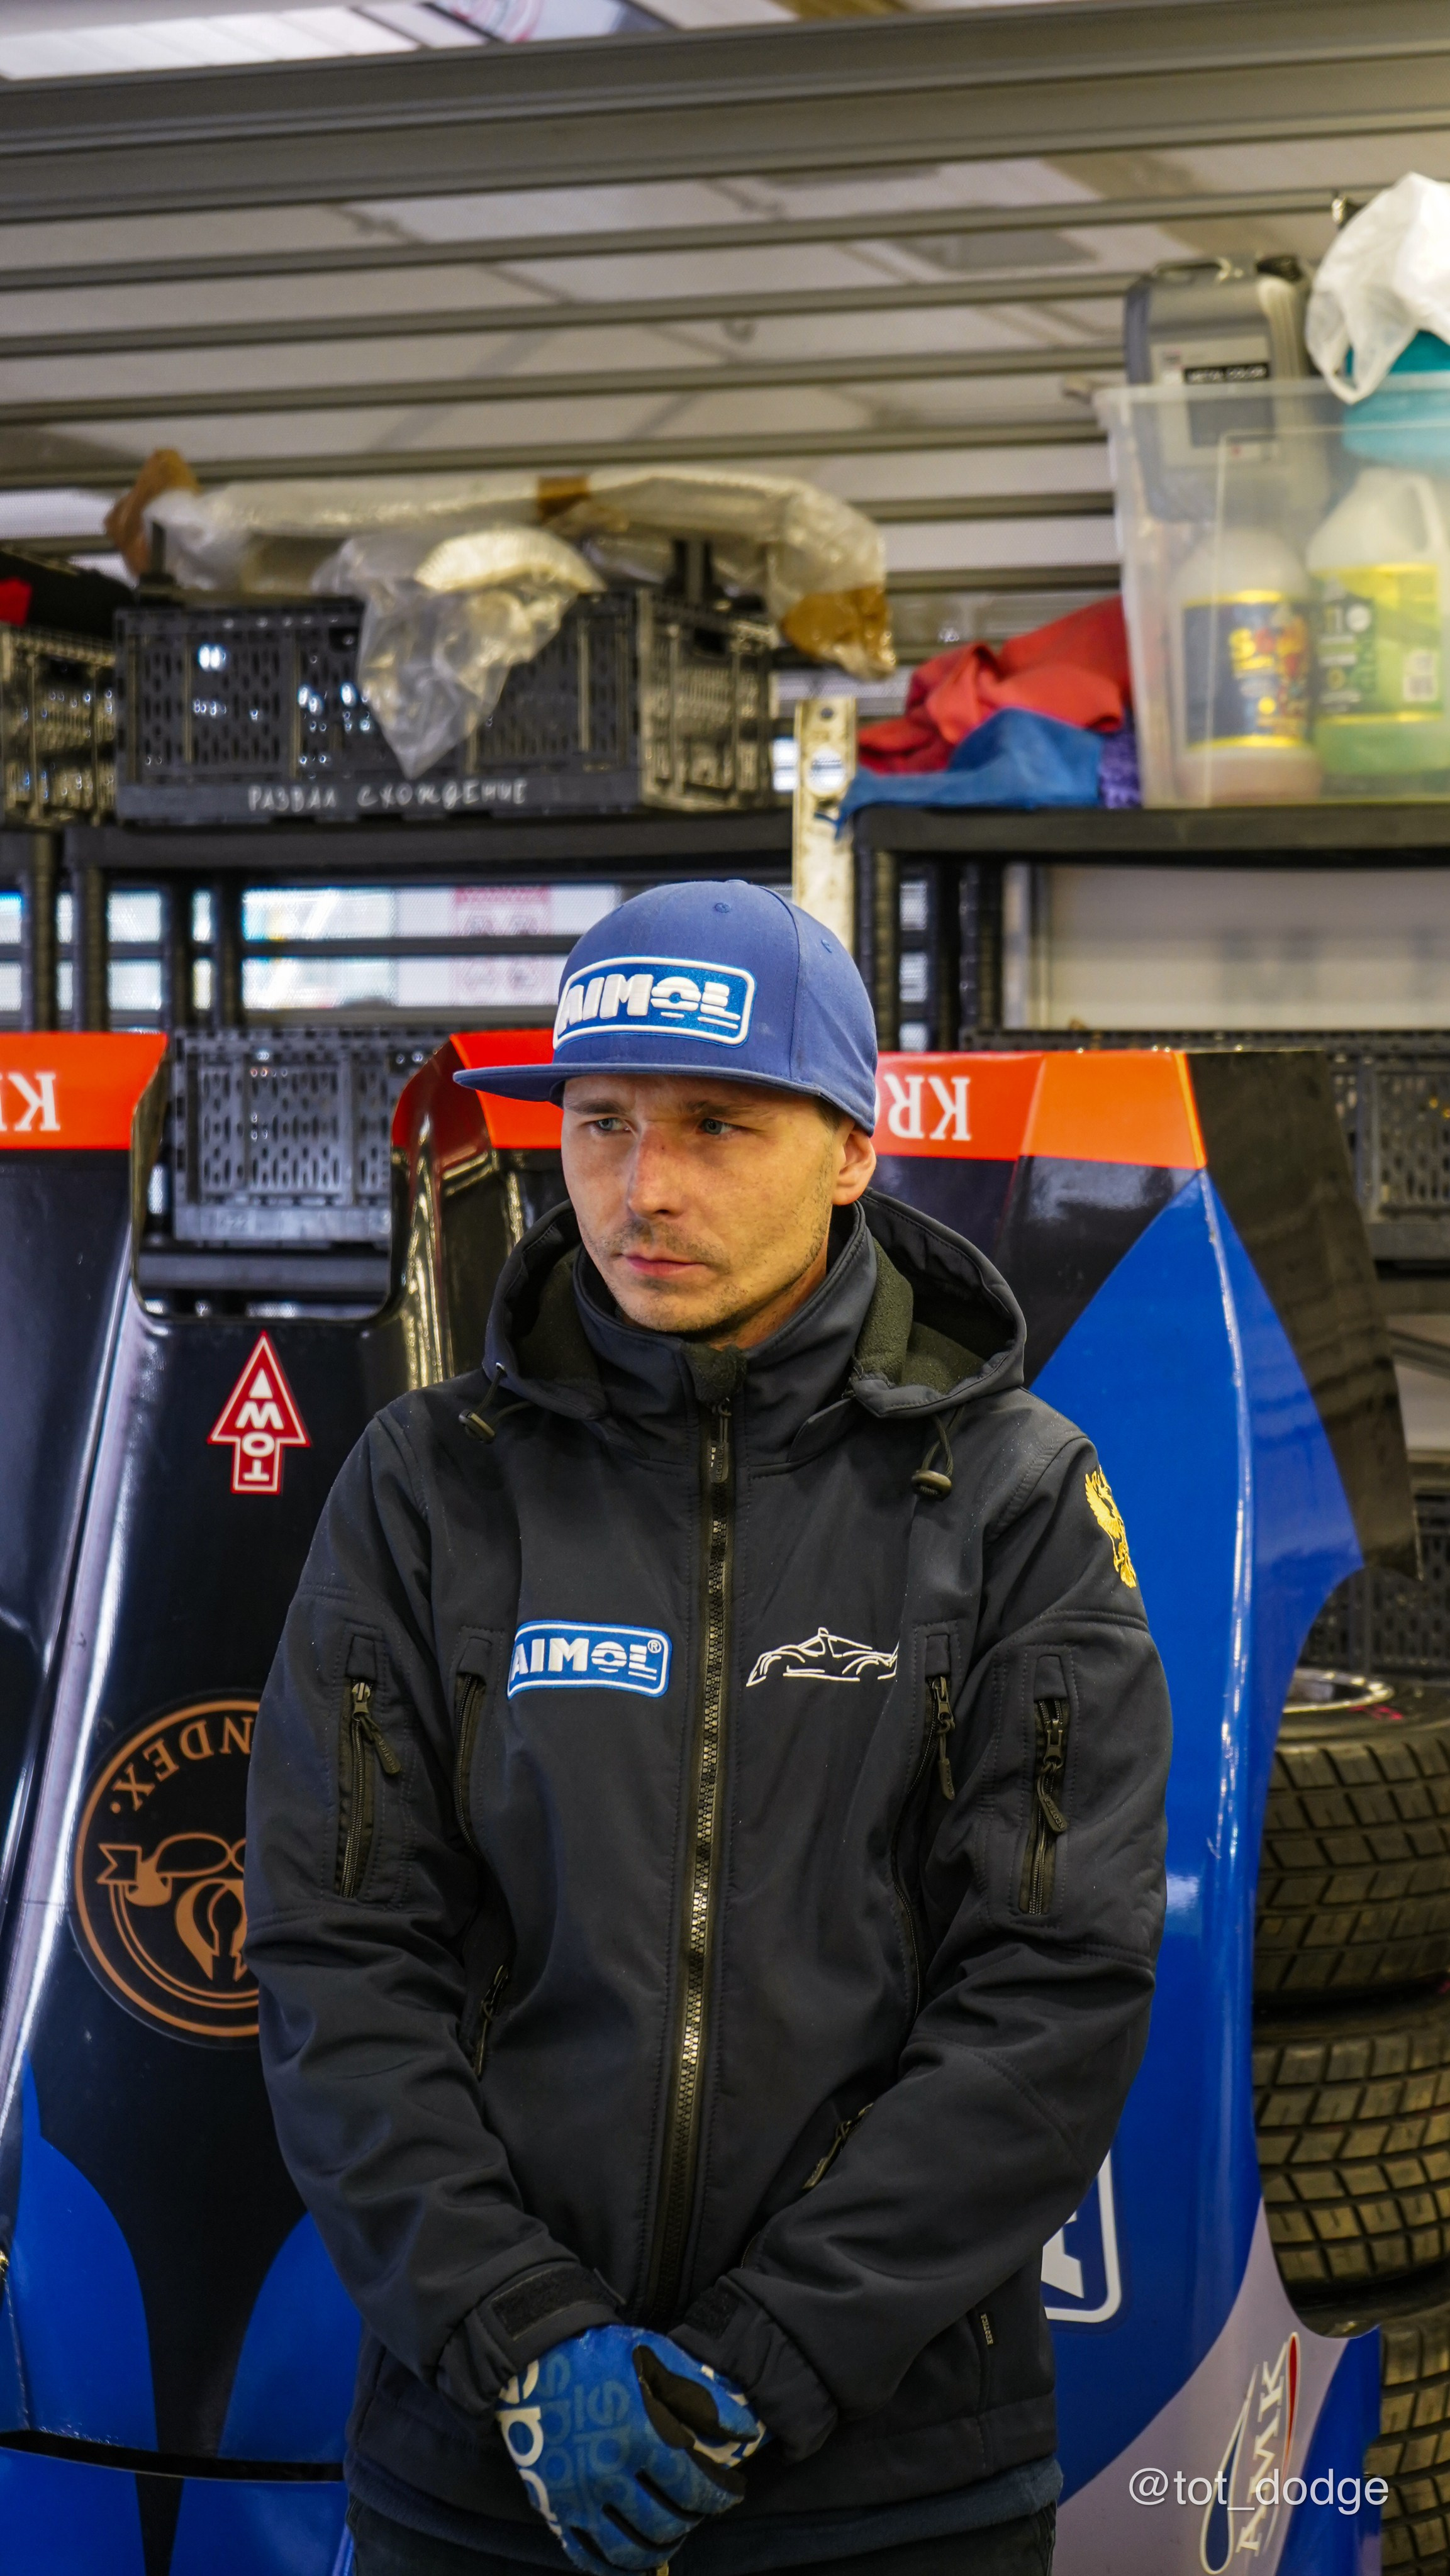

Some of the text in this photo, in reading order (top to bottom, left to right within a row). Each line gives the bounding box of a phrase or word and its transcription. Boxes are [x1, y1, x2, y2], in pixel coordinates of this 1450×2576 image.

[557, 973, 742, 1035] AIMOL
[0, 1071, 62, 1132] K
[874, 1073, 972, 1141] KR
